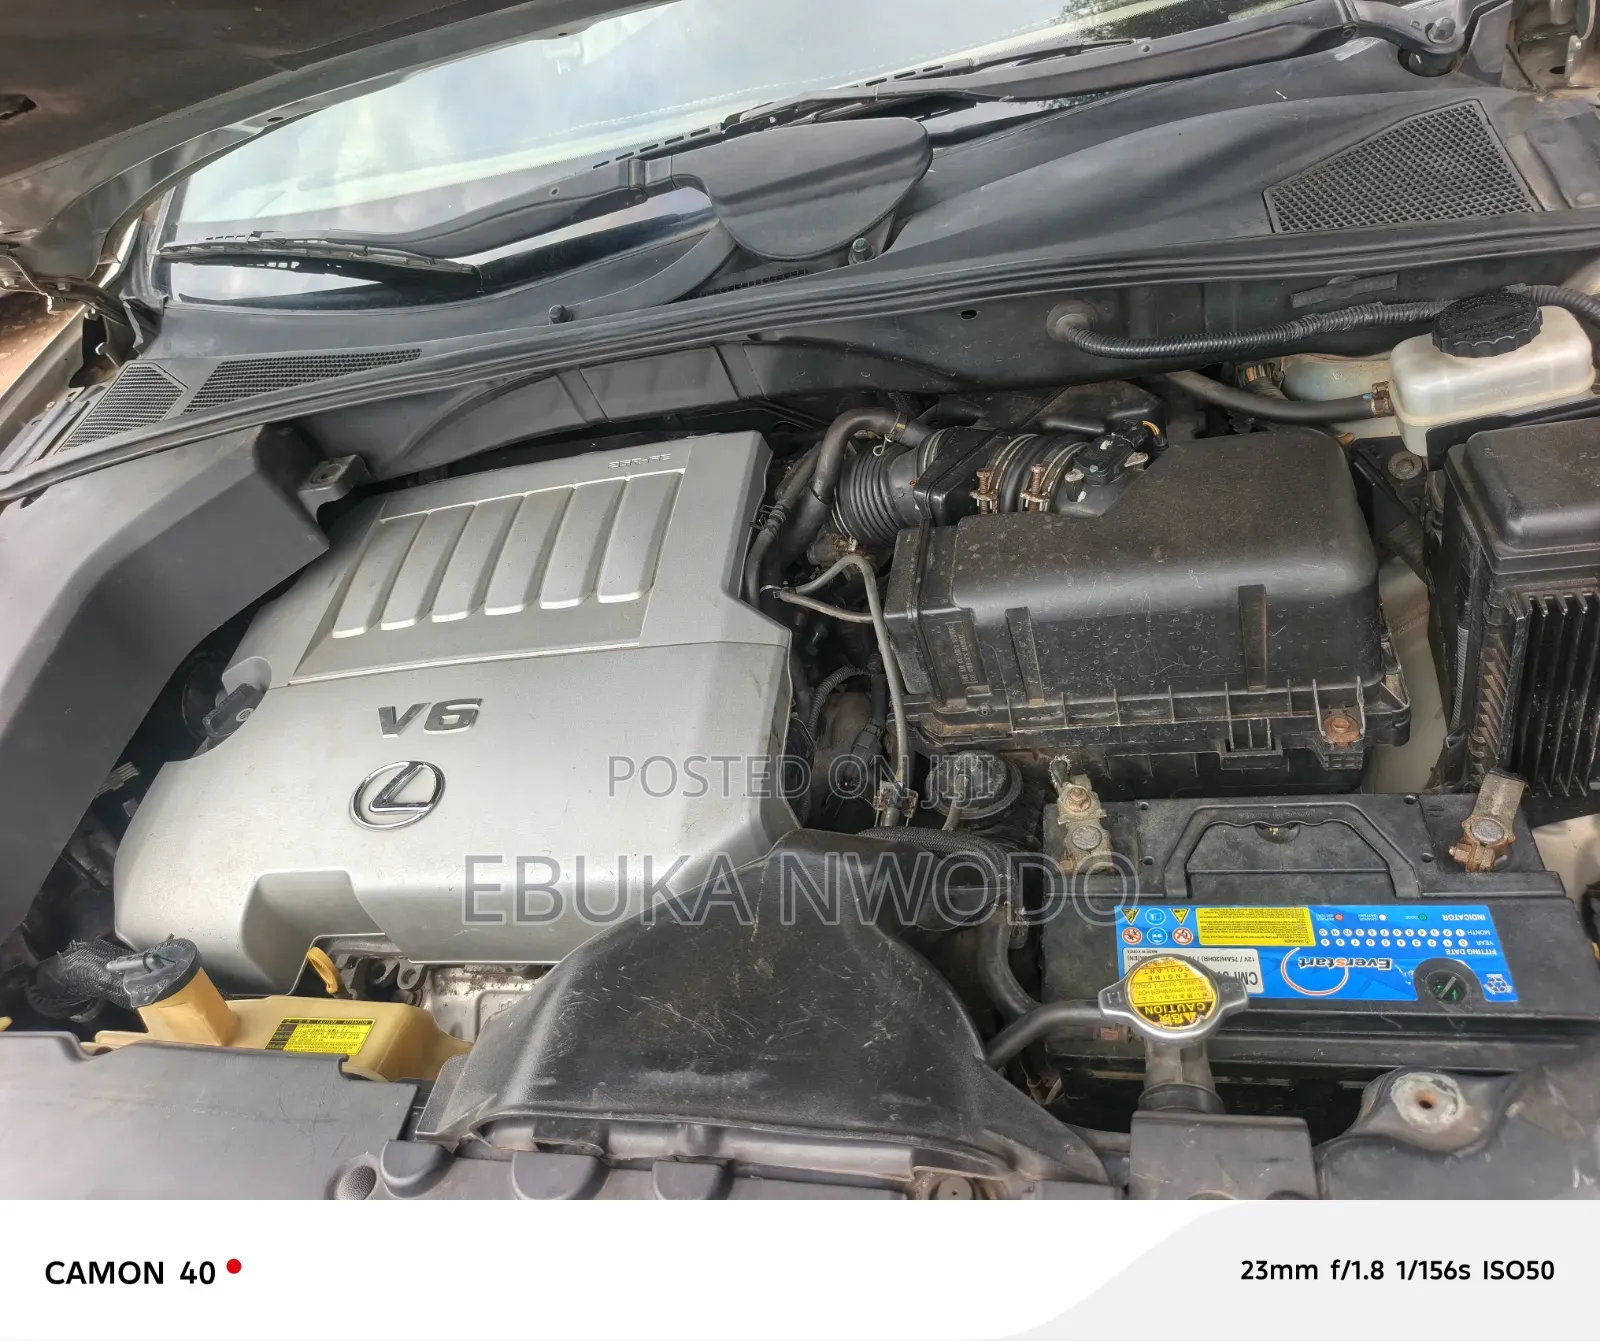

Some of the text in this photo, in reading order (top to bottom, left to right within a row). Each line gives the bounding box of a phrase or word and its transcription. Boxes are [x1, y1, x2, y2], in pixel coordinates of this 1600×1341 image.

[377, 698, 483, 738] V6
[1298, 958, 1392, 970] Everstart
[1144, 1002, 1205, 1015] CAUTION
